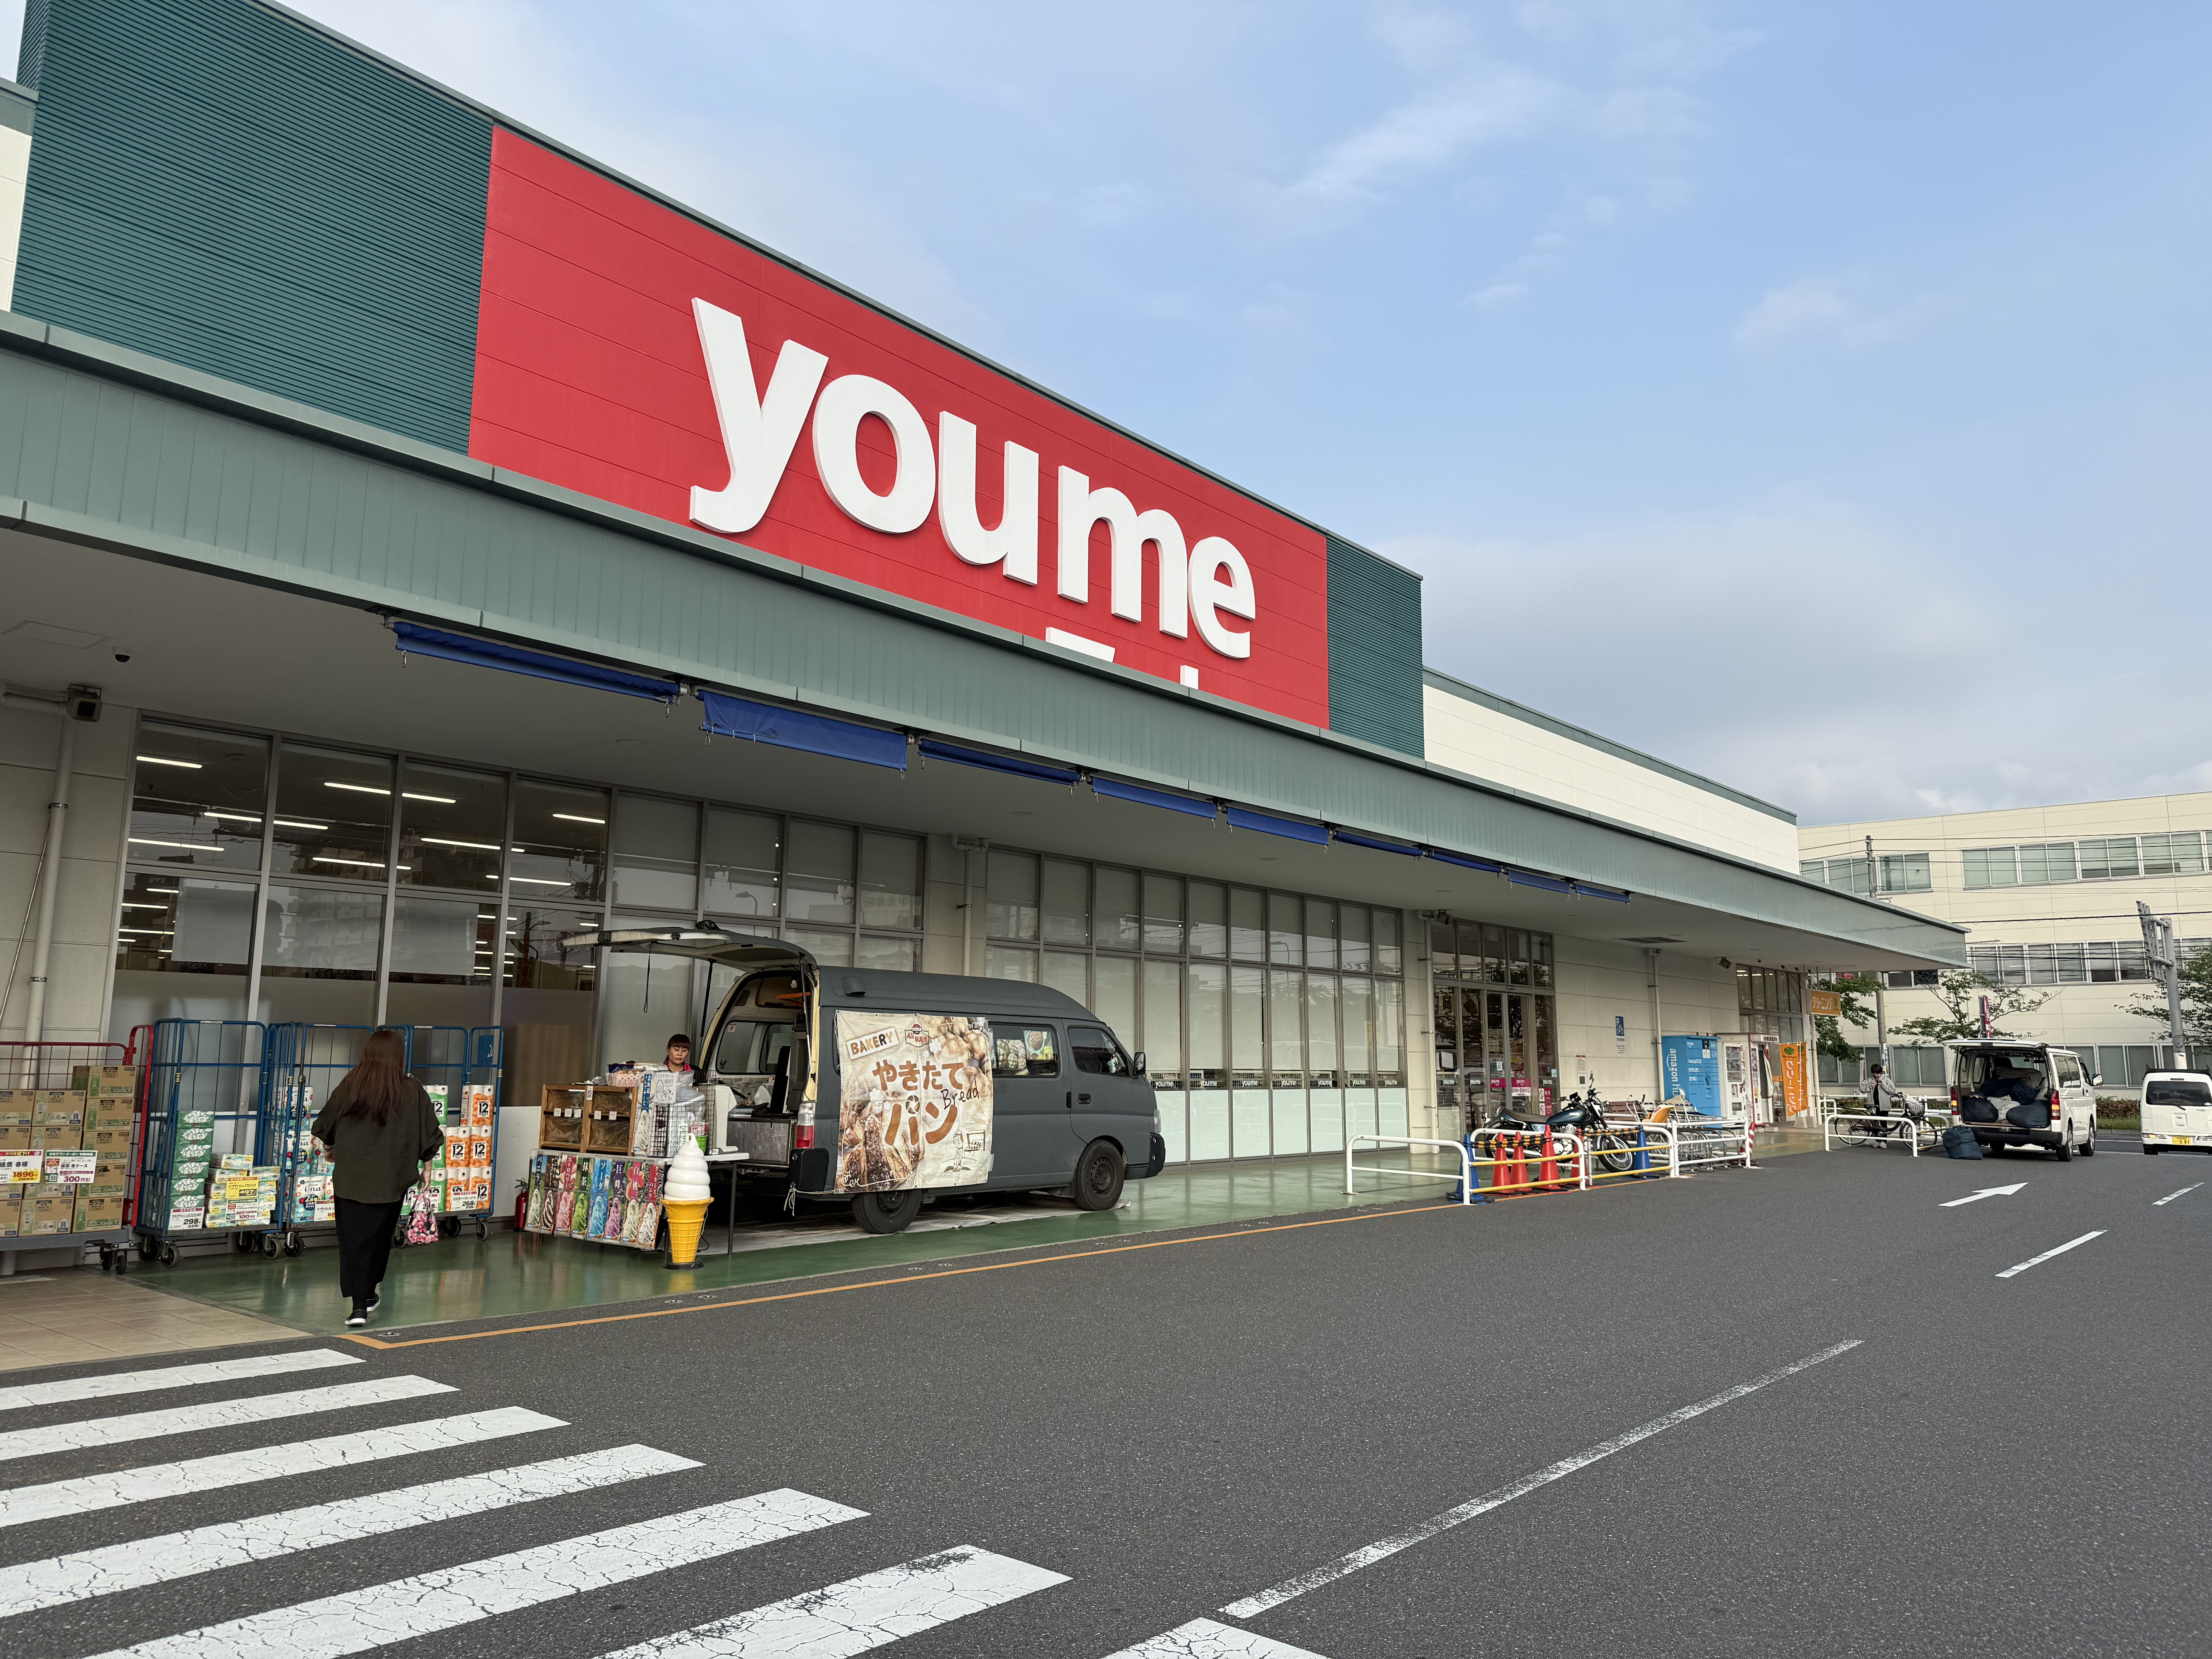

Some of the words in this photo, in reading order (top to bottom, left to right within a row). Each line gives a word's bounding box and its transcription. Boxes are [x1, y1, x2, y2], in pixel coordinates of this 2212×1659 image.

[1812, 996, 1832, 1010] クリーニング
[1616, 1018, 1620, 1026] P
[850, 1032, 892, 1055] BAKERY
[872, 1059, 964, 1091] やきたて
[1670, 1049, 1678, 1082] amazon
[941, 1077, 979, 1109] Bread
[1155, 1080, 1174, 1089] youme
[479, 1103, 489, 1115] 12
[884, 1095, 958, 1146] パン
[453, 1145, 463, 1157] 12
[475, 1144, 485, 1156] 12
[581, 1161, 589, 1186] 抹茶
[615, 1164, 622, 1189] 巨峰
[632, 1165, 639, 1190] 白桃
[478, 1186, 487, 1199] 12
